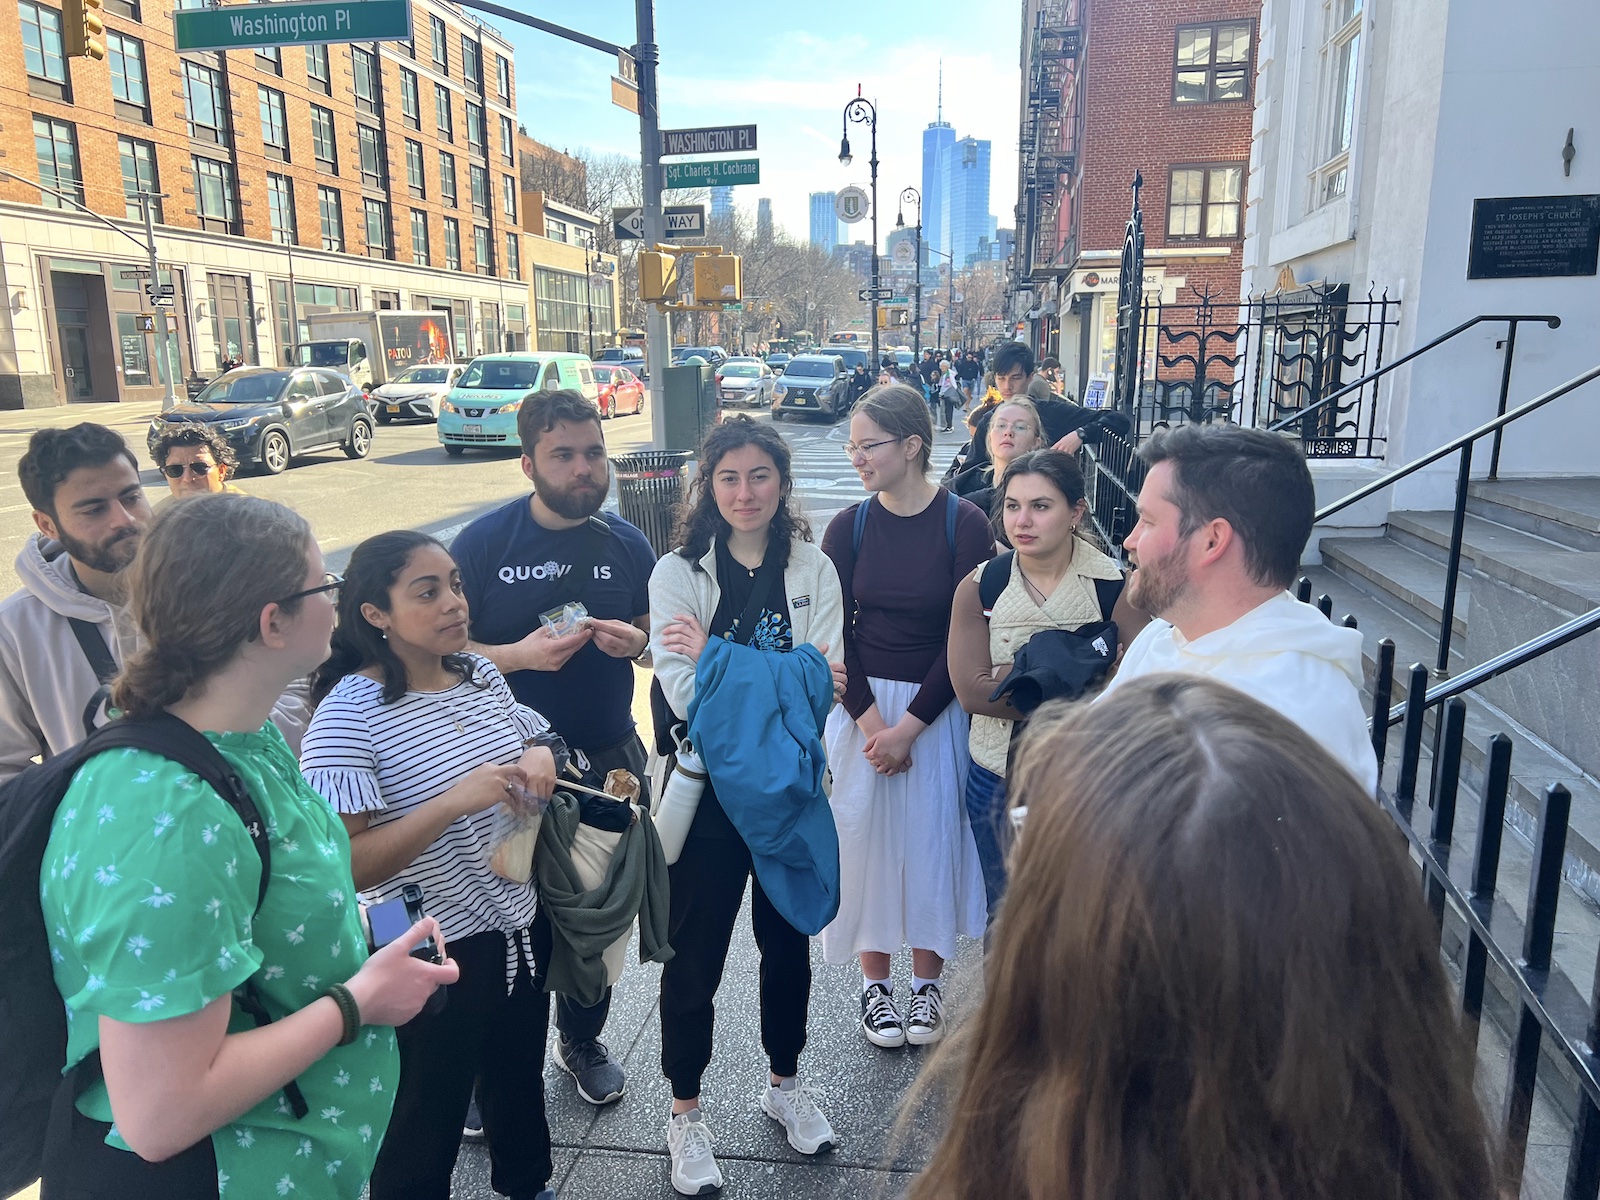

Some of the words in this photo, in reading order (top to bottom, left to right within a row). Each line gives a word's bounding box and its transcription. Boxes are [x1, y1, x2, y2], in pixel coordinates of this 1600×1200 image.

[230, 12, 328, 40] Washington
[335, 9, 350, 30] Pl
[623, 59, 628, 78] 6
[668, 130, 734, 153] WASHINGTON
[738, 129, 752, 148] PL
[668, 165, 682, 182] Sgt.
[684, 164, 710, 178] Charles
[713, 163, 721, 176] H.
[722, 162, 756, 175] Cochrane
[706, 177, 718, 185] Way
[668, 215, 694, 228] WAY
[1507, 212, 1544, 222] JOSEPH'S
[1547, 211, 1582, 220] CHURCH
[388, 348, 412, 360] PATOU
[1088, 390, 1105, 399] BARER
[498, 565, 547, 584] QUO
